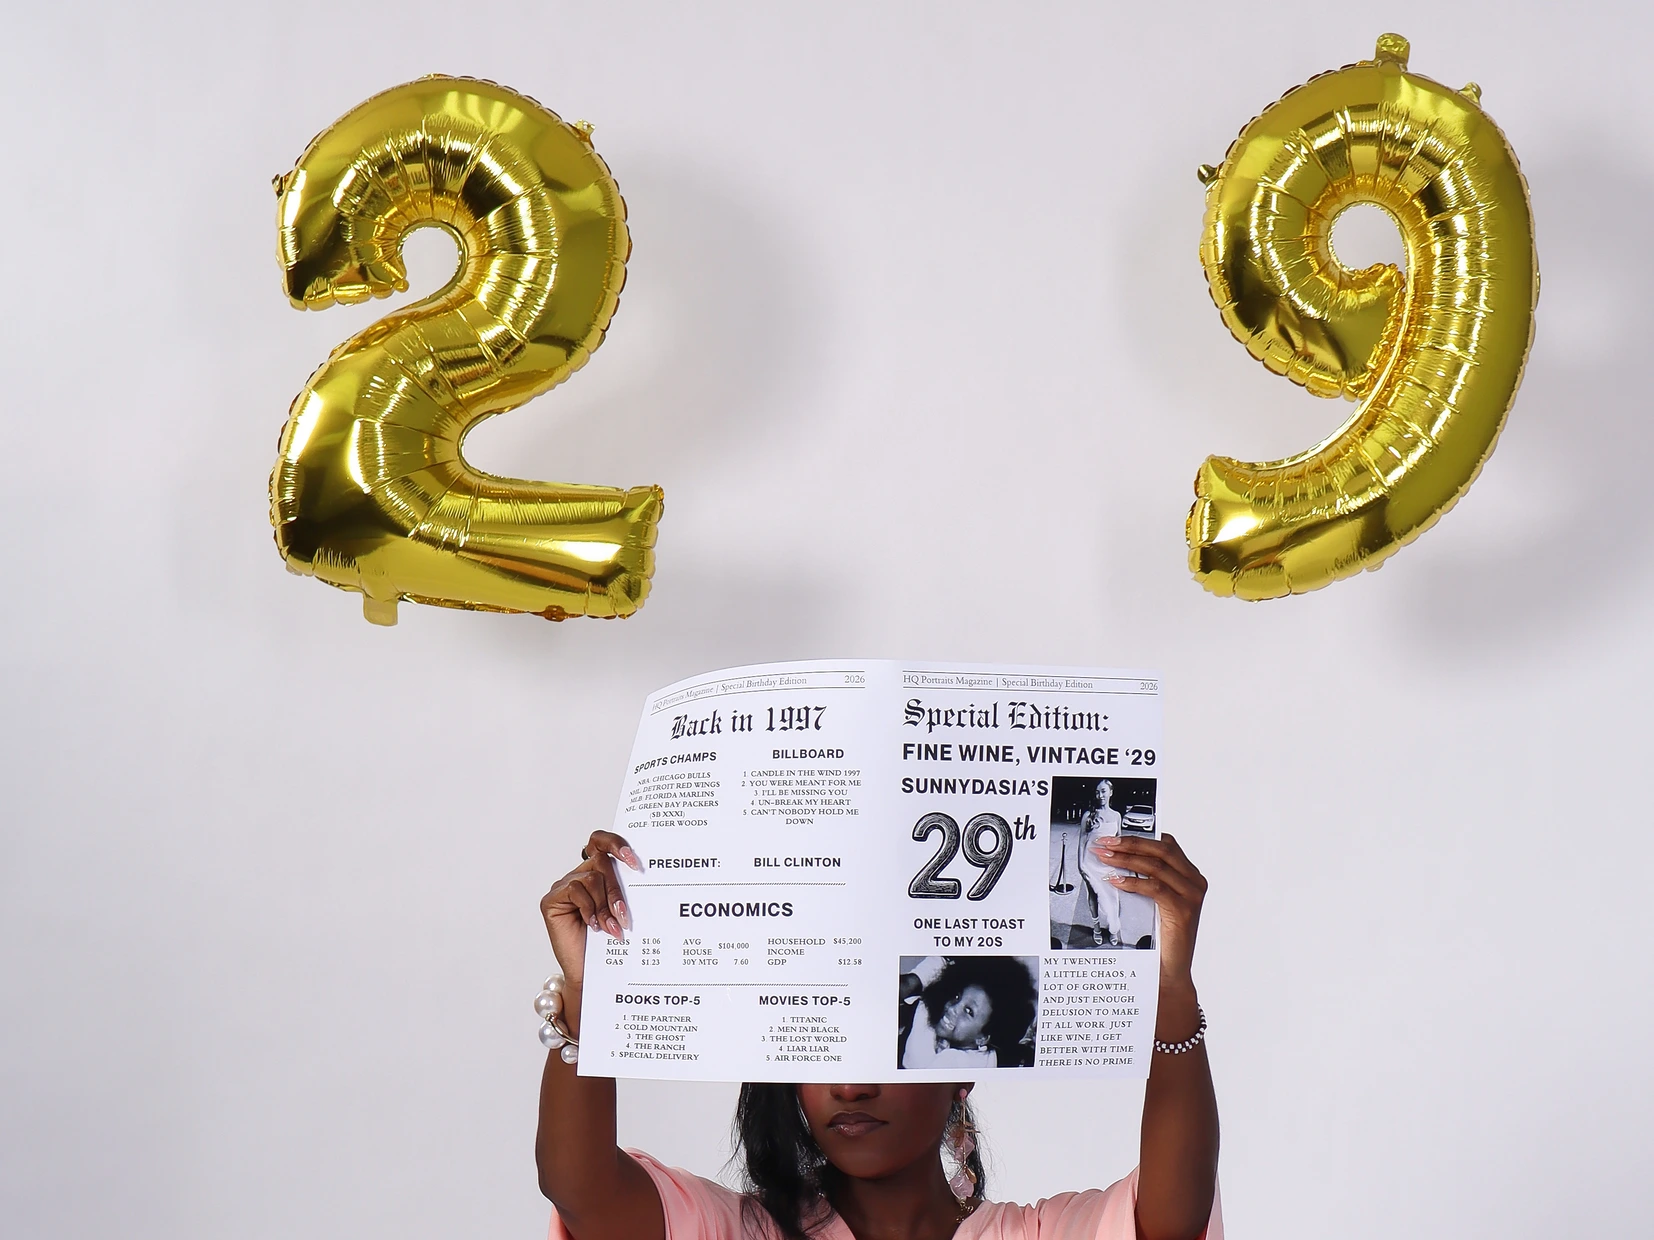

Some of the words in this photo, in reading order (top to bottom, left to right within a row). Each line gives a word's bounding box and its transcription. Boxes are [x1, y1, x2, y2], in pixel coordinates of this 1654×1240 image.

[1185, 58, 1540, 603] 9
[269, 73, 666, 620] 2
[685, 687, 713, 698] Magazine
[721, 681, 745, 692] Special
[746, 679, 777, 689] Birthday
[779, 677, 807, 685] Edition
[844, 675, 865, 683] 2026
[903, 675, 919, 684] HQ
[921, 675, 954, 686] Portraits
[956, 677, 993, 687] Magazine
[1002, 678, 1029, 688] Special
[1031, 679, 1064, 689] Birthday
[1065, 679, 1093, 689] Edition
[1140, 682, 1158, 690] 2026
[902, 698, 1000, 734] Special
[1008, 701, 1109, 732] Edition:
[670, 709, 722, 740] Back
[731, 710, 753, 732] in
[765, 706, 827, 731] 1997
[772, 749, 844, 758] BILLBOARD
[903, 744, 953, 761] FINE
[959, 745, 1021, 766] WINE,
[1027, 746, 1119, 764] VINTAGE
[634, 757, 668, 774] SPORTS
[670, 752, 716, 764] CHAMPS
[652, 774, 685, 782] CHICAGO
[643, 783, 674, 792] DETROIT
[645, 792, 677, 800] FLORIDA
[639, 802, 663, 810] GREEN
[908, 812, 1036, 901] 29th
[649, 858, 721, 868] PRESIDENT:
[754, 858, 780, 867] BILL
[784, 858, 841, 867] CLINTON
[680, 903, 794, 917] ECONOMICS
[914, 918, 941, 930] ONE
[945, 918, 978, 930] LAST
[982, 918, 1025, 930] TOAST
[934, 936, 952, 947] TO
[954, 936, 974, 947] MY
[978, 937, 1003, 947] 20S
[616, 994, 660, 1004] BOOKS
[664, 996, 700, 1005] TOP-5
[759, 996, 808, 1005] MOVIES
[812, 996, 850, 1006] TOP-5
[1066, 997, 1090, 1005] JUST
[1112, 1008, 1139, 1016] MAKE
[1109, 1021, 1132, 1030] JUST
[1066, 1034, 1093, 1042] WINE,
